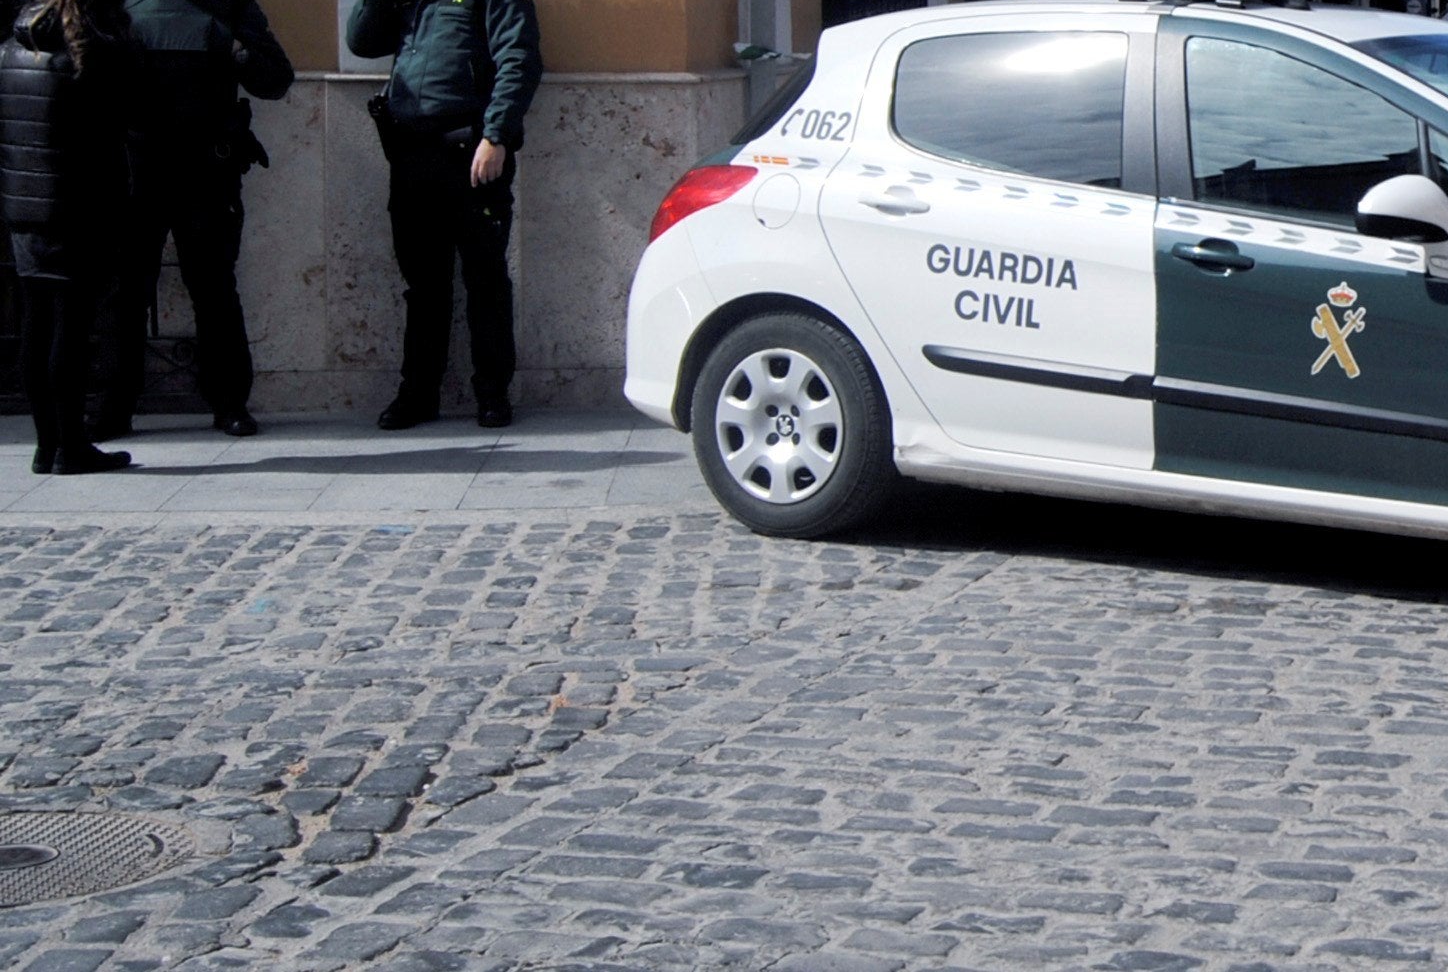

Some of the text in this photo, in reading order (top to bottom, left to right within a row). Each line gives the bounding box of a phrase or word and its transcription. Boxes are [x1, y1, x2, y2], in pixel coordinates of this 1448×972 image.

[801, 109, 852, 141] 062
[926, 243, 1078, 290] GUARDIA
[954, 289, 1040, 329] CIVIL
